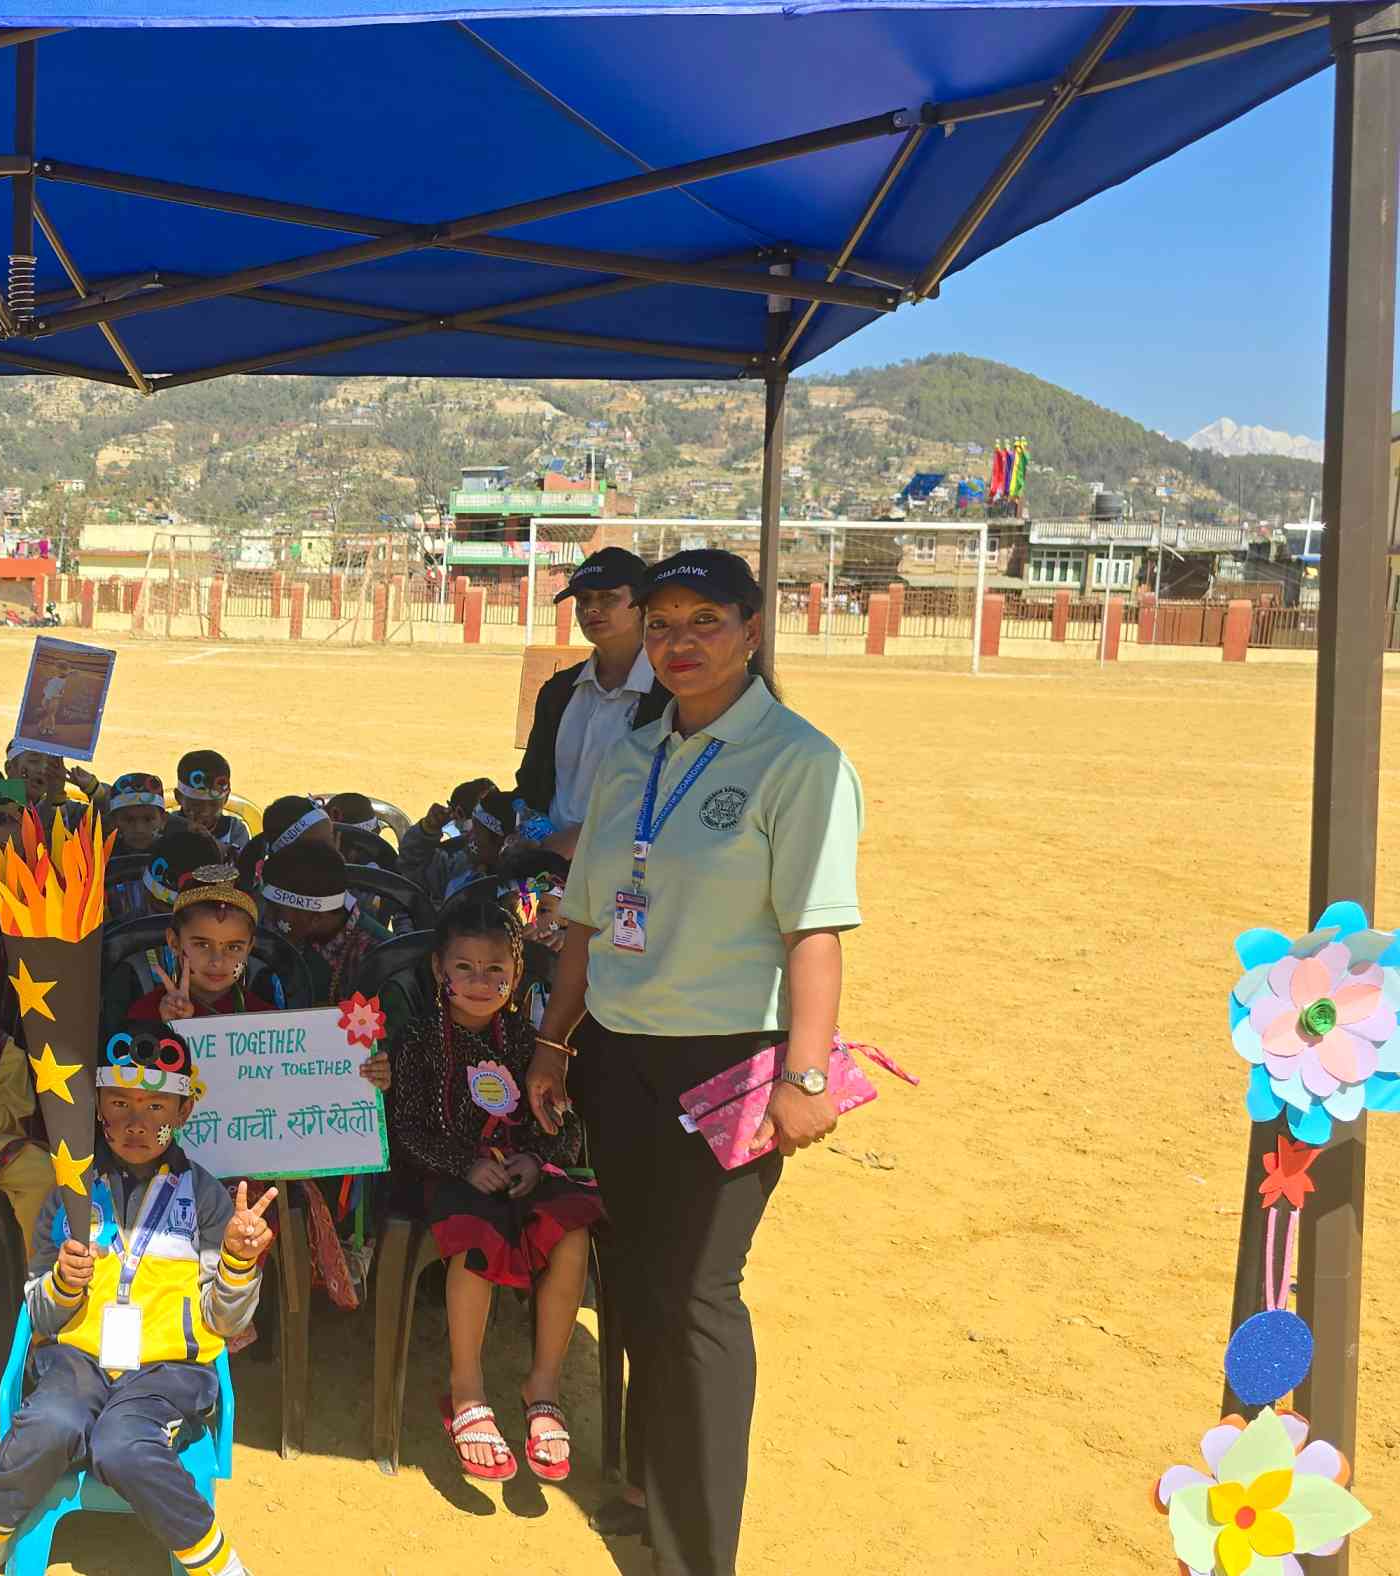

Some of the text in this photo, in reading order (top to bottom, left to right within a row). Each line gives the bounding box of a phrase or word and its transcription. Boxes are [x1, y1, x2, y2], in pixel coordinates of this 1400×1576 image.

[273, 888, 322, 910] SPORTS
[187, 1028, 306, 1058] IVE TOGETHER
[238, 1060, 352, 1080] PLAY TOGETHER
